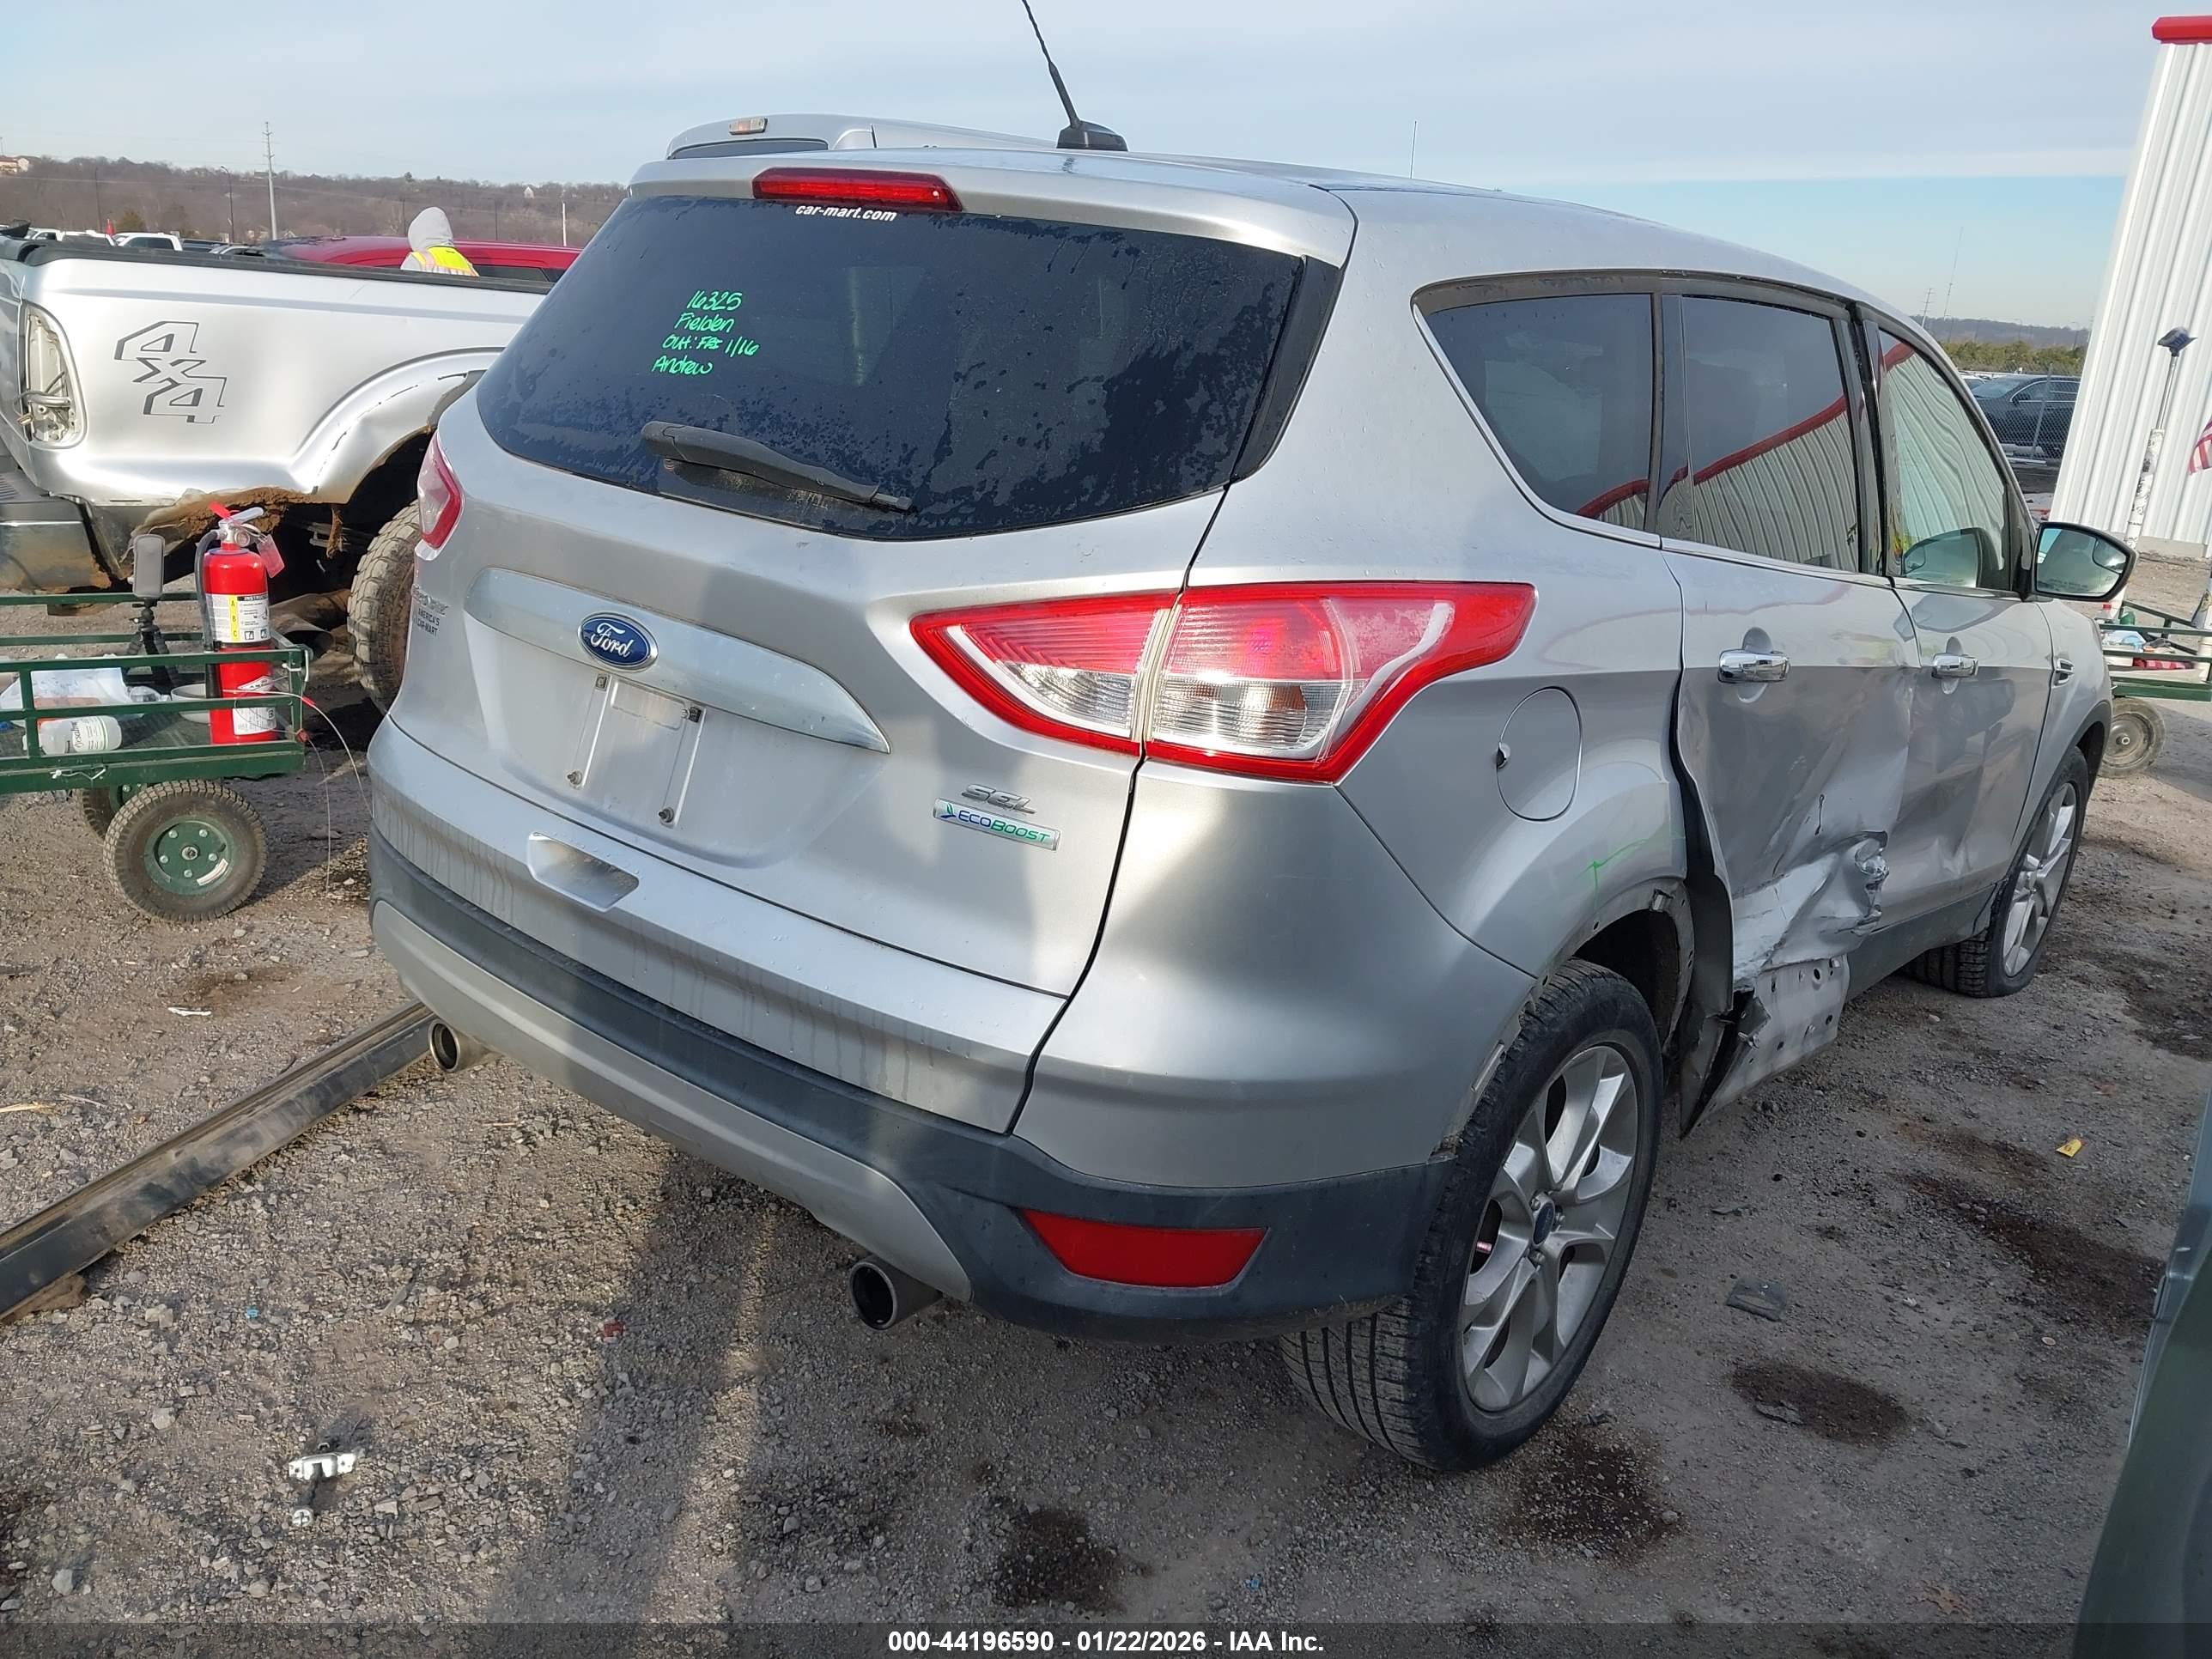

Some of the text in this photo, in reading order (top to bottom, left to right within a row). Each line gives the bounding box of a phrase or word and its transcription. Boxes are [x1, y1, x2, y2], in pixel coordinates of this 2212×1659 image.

[795, 205, 897, 222] car-mart.com
[686, 290, 743, 310] 16325
[674, 313, 734, 333] Fielden
[725, 336, 760, 358] 1/16
[651, 355, 714, 375] Andrew
[590, 623, 635, 658] Ford
[961, 783, 1036, 815] SEL
